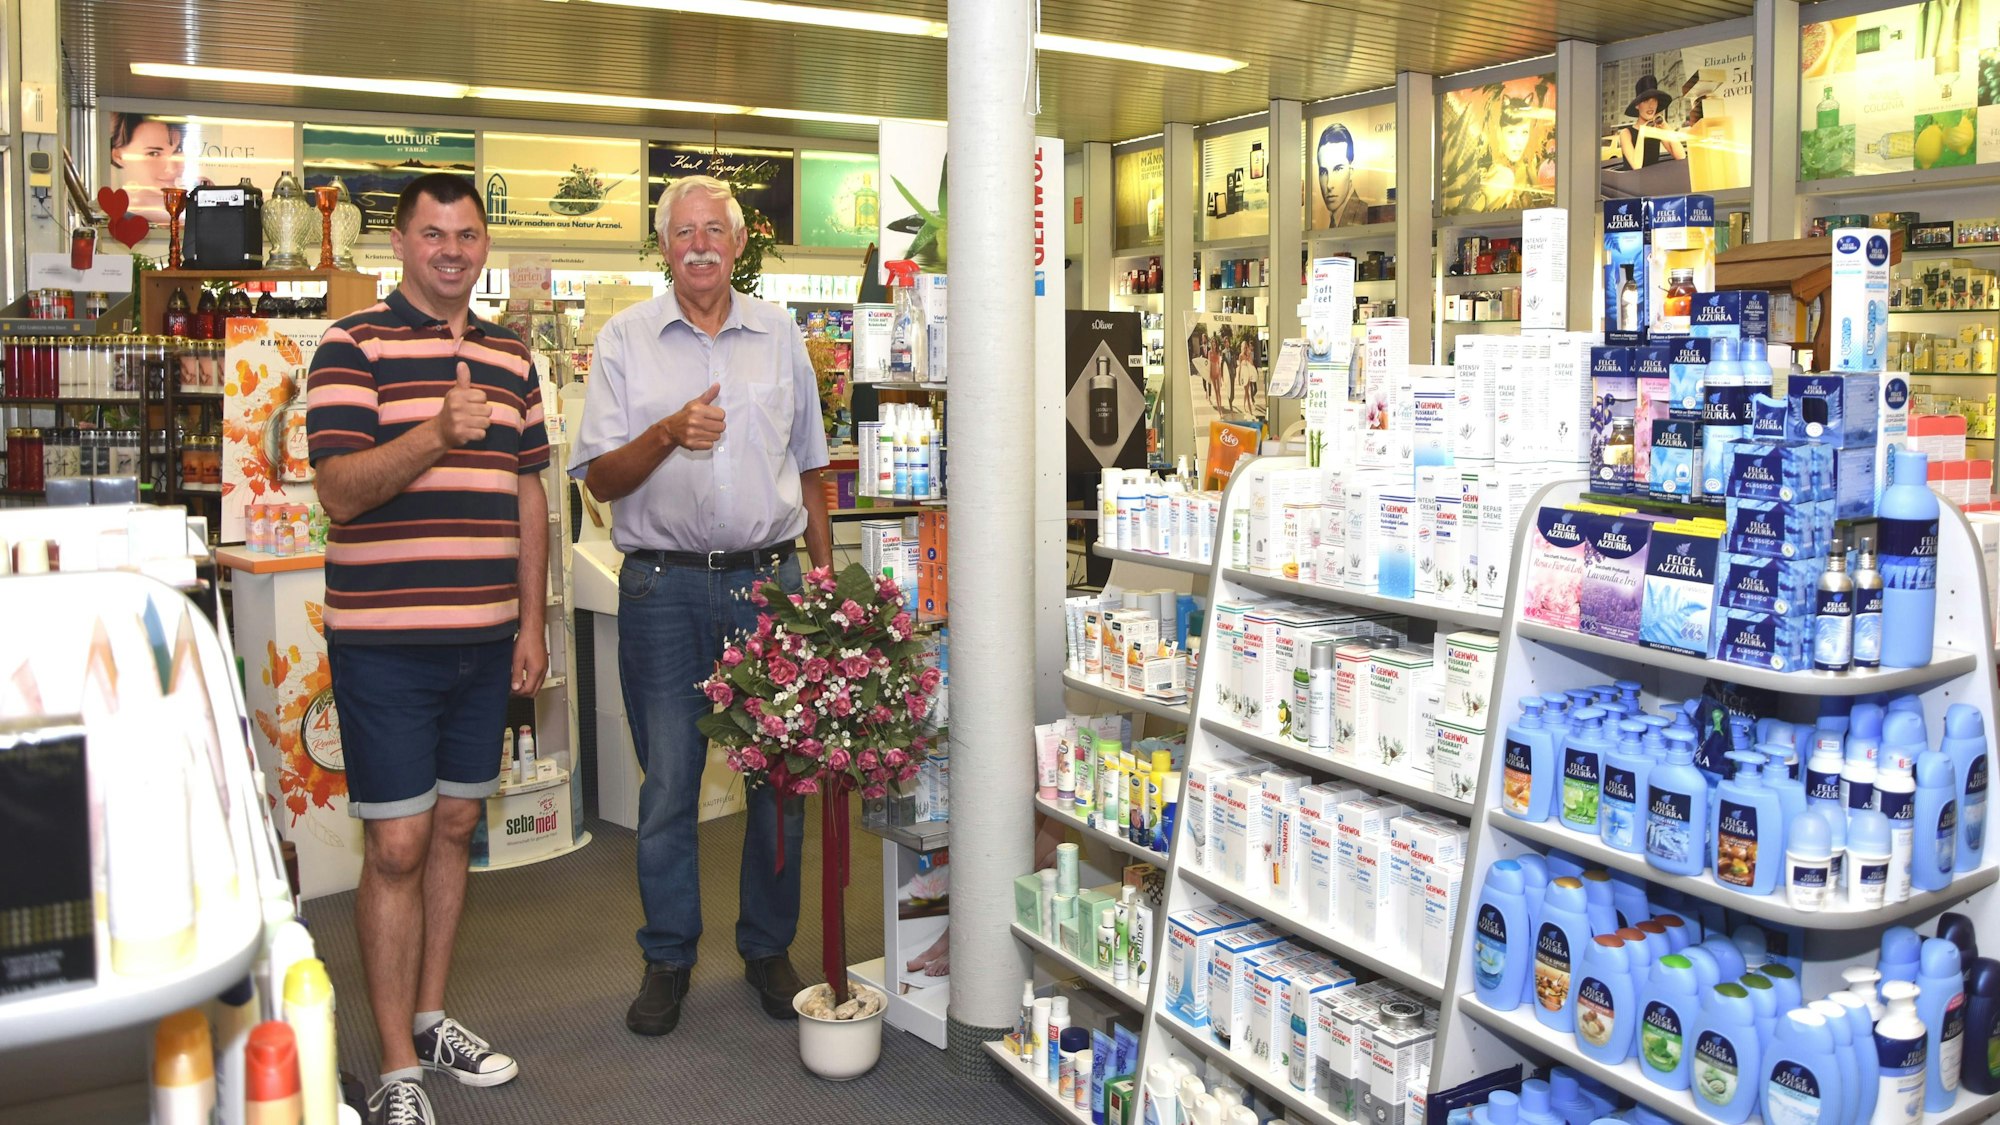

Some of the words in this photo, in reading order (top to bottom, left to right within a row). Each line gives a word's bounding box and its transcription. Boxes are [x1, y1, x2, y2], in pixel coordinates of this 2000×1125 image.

[1704, 54, 1746, 68] Elizabeth
[1723, 84, 1752, 98] aven
[385, 135, 440, 145] CULTURE
[670, 155, 701, 170] Karl
[1141, 153, 1163, 166] MÄNN
[1607, 220, 1639, 228] AZZURRA
[1652, 215, 1681, 223] AZZURRA
[1314, 286, 1332, 294] Soft
[1314, 294, 1332, 303] Feet
[1703, 306, 1725, 314] FELCE
[1697, 314, 1732, 322] AZZURRA
[1867, 300, 1876, 356] UOMO
[1368, 348, 1386, 358] Soft
[1368, 358, 1386, 367] Feet
[1309, 390, 1327, 398] Soft
[1309, 400, 1327, 408] Feet
[1421, 402, 1443, 410] GEHWOL
[1661, 432, 1681, 440] FELCE
[1656, 439, 1687, 447] AZZURRA
[1743, 473, 1774, 481] AZZURRA
[1386, 505, 1408, 514] GEHWOL
[1436, 512, 1457, 520] GEHWOL
[1553, 523, 1576, 533] FELCE
[1750, 521, 1770, 530] FELCE
[1547, 530, 1580, 541] AZZURRA
[1603, 532, 1628, 543] FELCE
[1745, 528, 1776, 537] AZZURRA
[1597, 539, 1632, 552] AZZURRA
[1667, 554, 1696, 567] FELCE
[1657, 564, 1703, 578] AZZURRA
[1587, 570, 1618, 585] Lavanda
[1624, 576, 1637, 587] Iris
[1743, 577, 1764, 586] FELCE
[1738, 583, 1769, 594] AZZURRA
[1740, 632, 1761, 641] FELCE
[1735, 638, 1766, 648] AZZURRA
[1454, 651, 1479, 662] GEHWOL
[1376, 667, 1399, 679] GEHWOL
[1444, 732, 1469, 744] GEHWOL
[1566, 768, 1597, 779] AZZURRA
[1570, 763, 1590, 772] FELCE
[1188, 780, 1205, 791] GEHWOL
[1608, 779, 1627, 791] FELCE
[1262, 790, 1281, 802] GEHWOL
[1605, 786, 1634, 799] AZZURRA
[1227, 799, 1247, 810] GEHWOL
[1655, 801, 1676, 812] FELCE
[1300, 807, 1321, 819] GEHWOL
[1651, 808, 1683, 820] AZZURRA
[1725, 817, 1748, 827] FELCE
[1338, 824, 1360, 837] GEHWOL
[1721, 824, 1755, 836] AZZURRA
[1312, 837, 1330, 848] GEHWOL
[1357, 854, 1376, 866] GEHWOL
[1411, 850, 1434, 864] GEHWOL
[1426, 884, 1447, 897] GEHWOL
[1481, 916, 1499, 928] FELCE
[1478, 921, 1504, 939] AZZURRA
[1174, 929, 1195, 948] GEHWOL
[1542, 936, 1562, 949] FELCE
[1538, 941, 1568, 958] AZZURRA
[1215, 958, 1232, 971] GEHWOL
[1254, 983, 1272, 996] GEHWOL
[1586, 985, 1605, 999] FELCE
[1581, 990, 1610, 1007] AZZURRA
[1651, 1011, 1673, 1024] FELCE
[1646, 1015, 1678, 1034] AZZURRA
[1332, 1030, 1351, 1044] GEHWOL
[1332, 1037, 1345, 1047] EXTRA
[1705, 1040, 1727, 1053] FELCE
[1700, 1044, 1733, 1064] AZZURRA
[1373, 1054, 1393, 1068] GEHWOL
[1782, 1070, 1808, 1084] FELCE
[1775, 1075, 1814, 1095] AZZURRA
